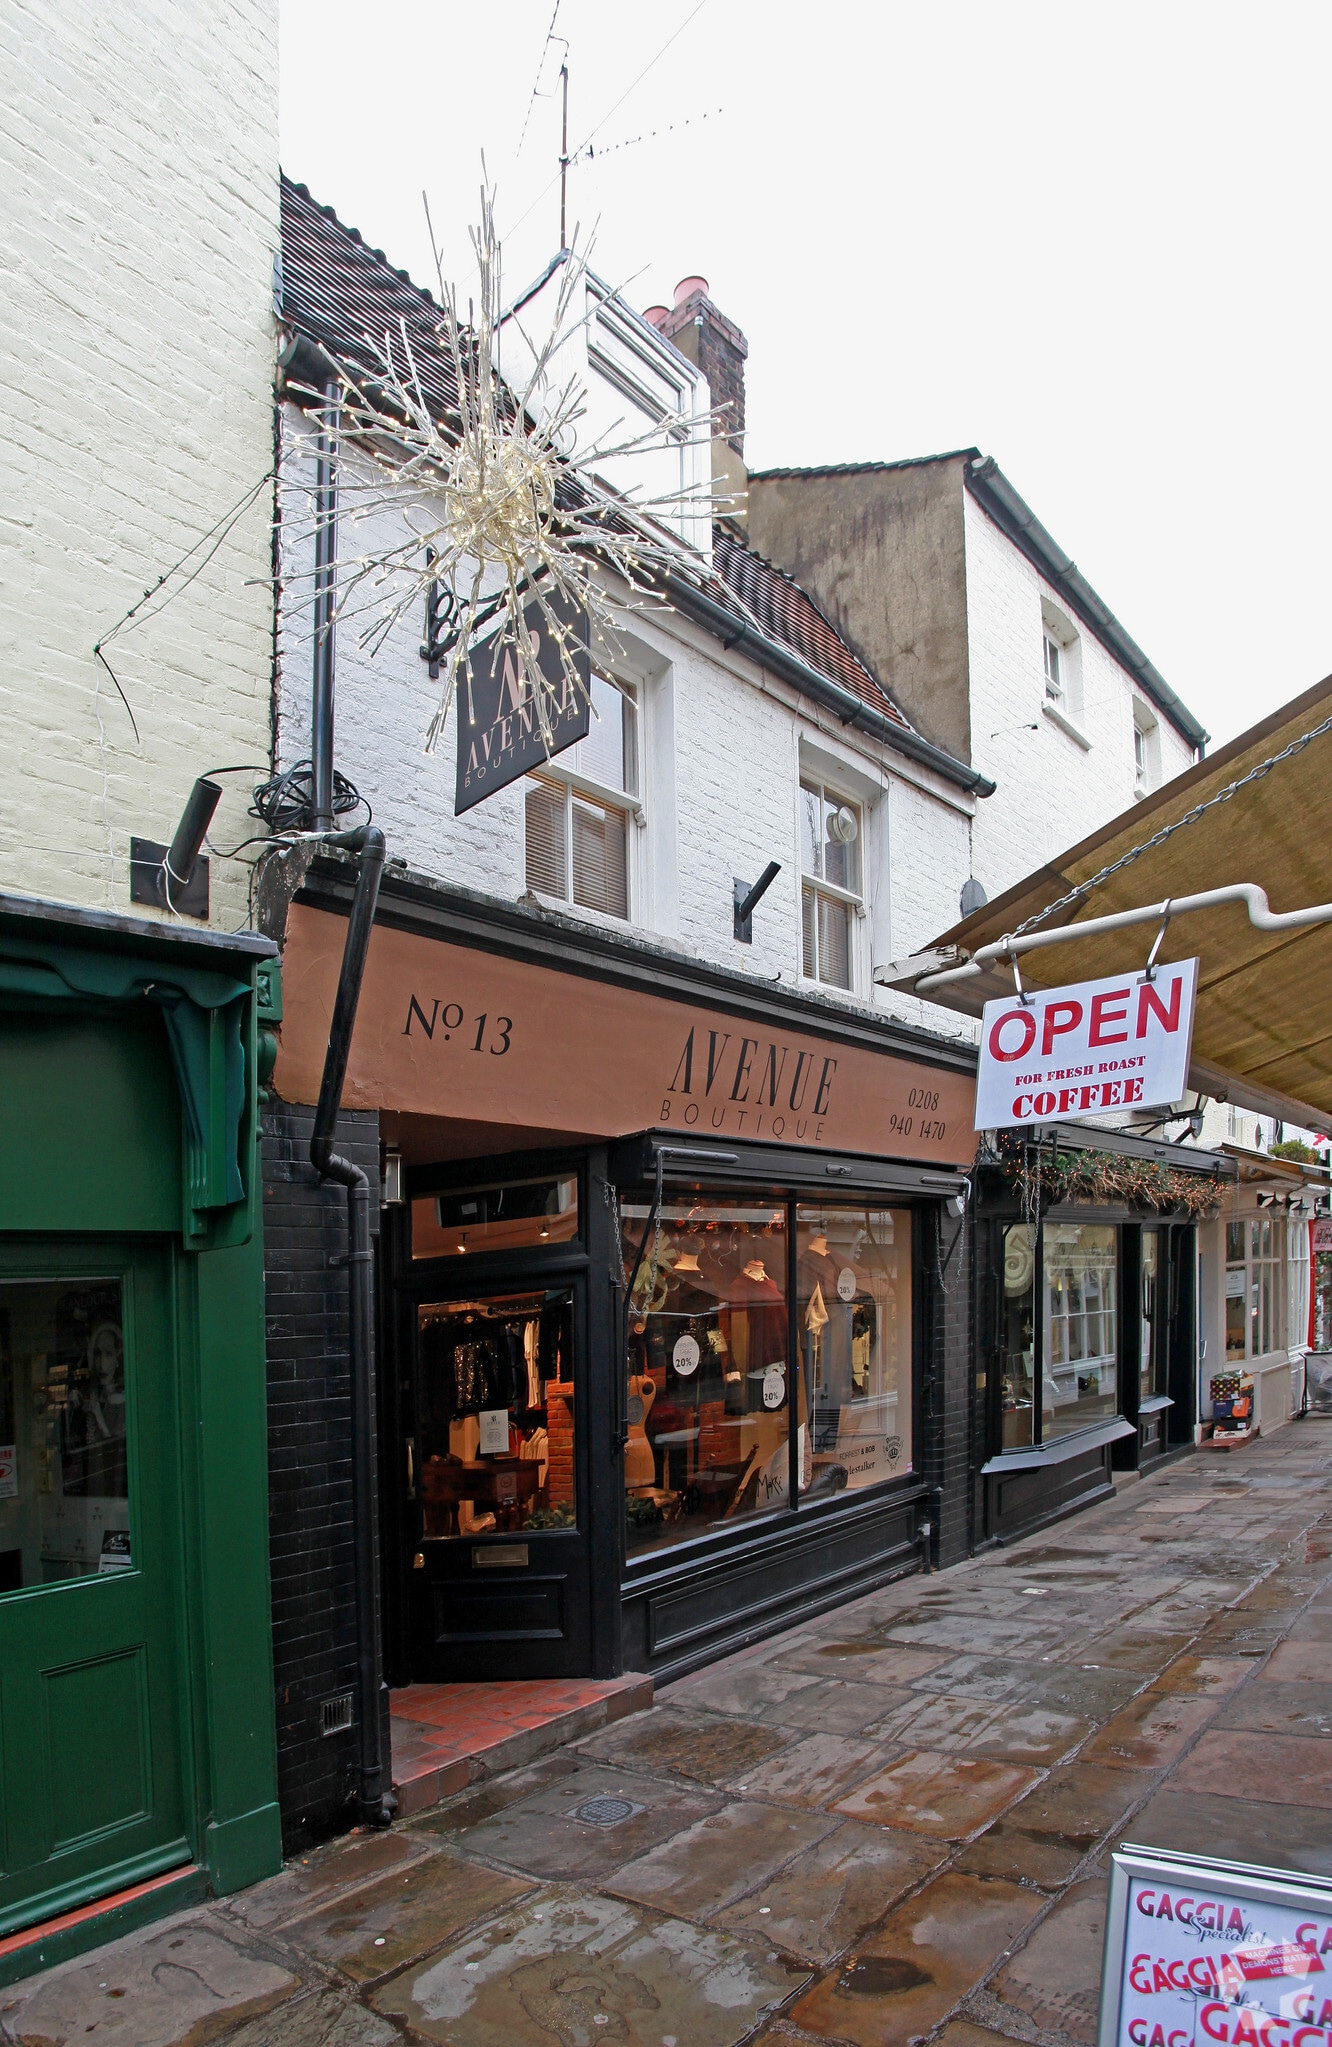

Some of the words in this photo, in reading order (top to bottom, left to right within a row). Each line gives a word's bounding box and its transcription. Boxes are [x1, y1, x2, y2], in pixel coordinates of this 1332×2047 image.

[465, 676, 577, 775] AVENUE
[464, 711, 574, 788] BOUTIQUE
[470, 1013, 513, 1056] 13
[988, 976, 1183, 1063] OPEN
[666, 1025, 839, 1118] AVENUE
[1014, 1073, 1043, 1087] FOR
[1046, 1064, 1094, 1082] FRESH
[1097, 1055, 1147, 1073] ROAST
[908, 1088, 940, 1111] 0208
[1011, 1076, 1145, 1119] COFFEE
[658, 1099, 828, 1142] BOUTIQUE
[889, 1114, 913, 1136] 940
[919, 1119, 946, 1140] 1470
[675, 1357, 692, 1368] 20%
[764, 1391, 779, 1402] 20%
[1136, 1890, 1245, 1934] GAGGIA
[1242, 1952, 1318, 1970] DEMONSTRATION
[1244, 1945, 1291, 1959] MACHINES
[1291, 1943, 1307, 1953] ON
[1269, 1965, 1296, 1975] HERE
[1129, 1952, 1244, 1994] GAGGIA
